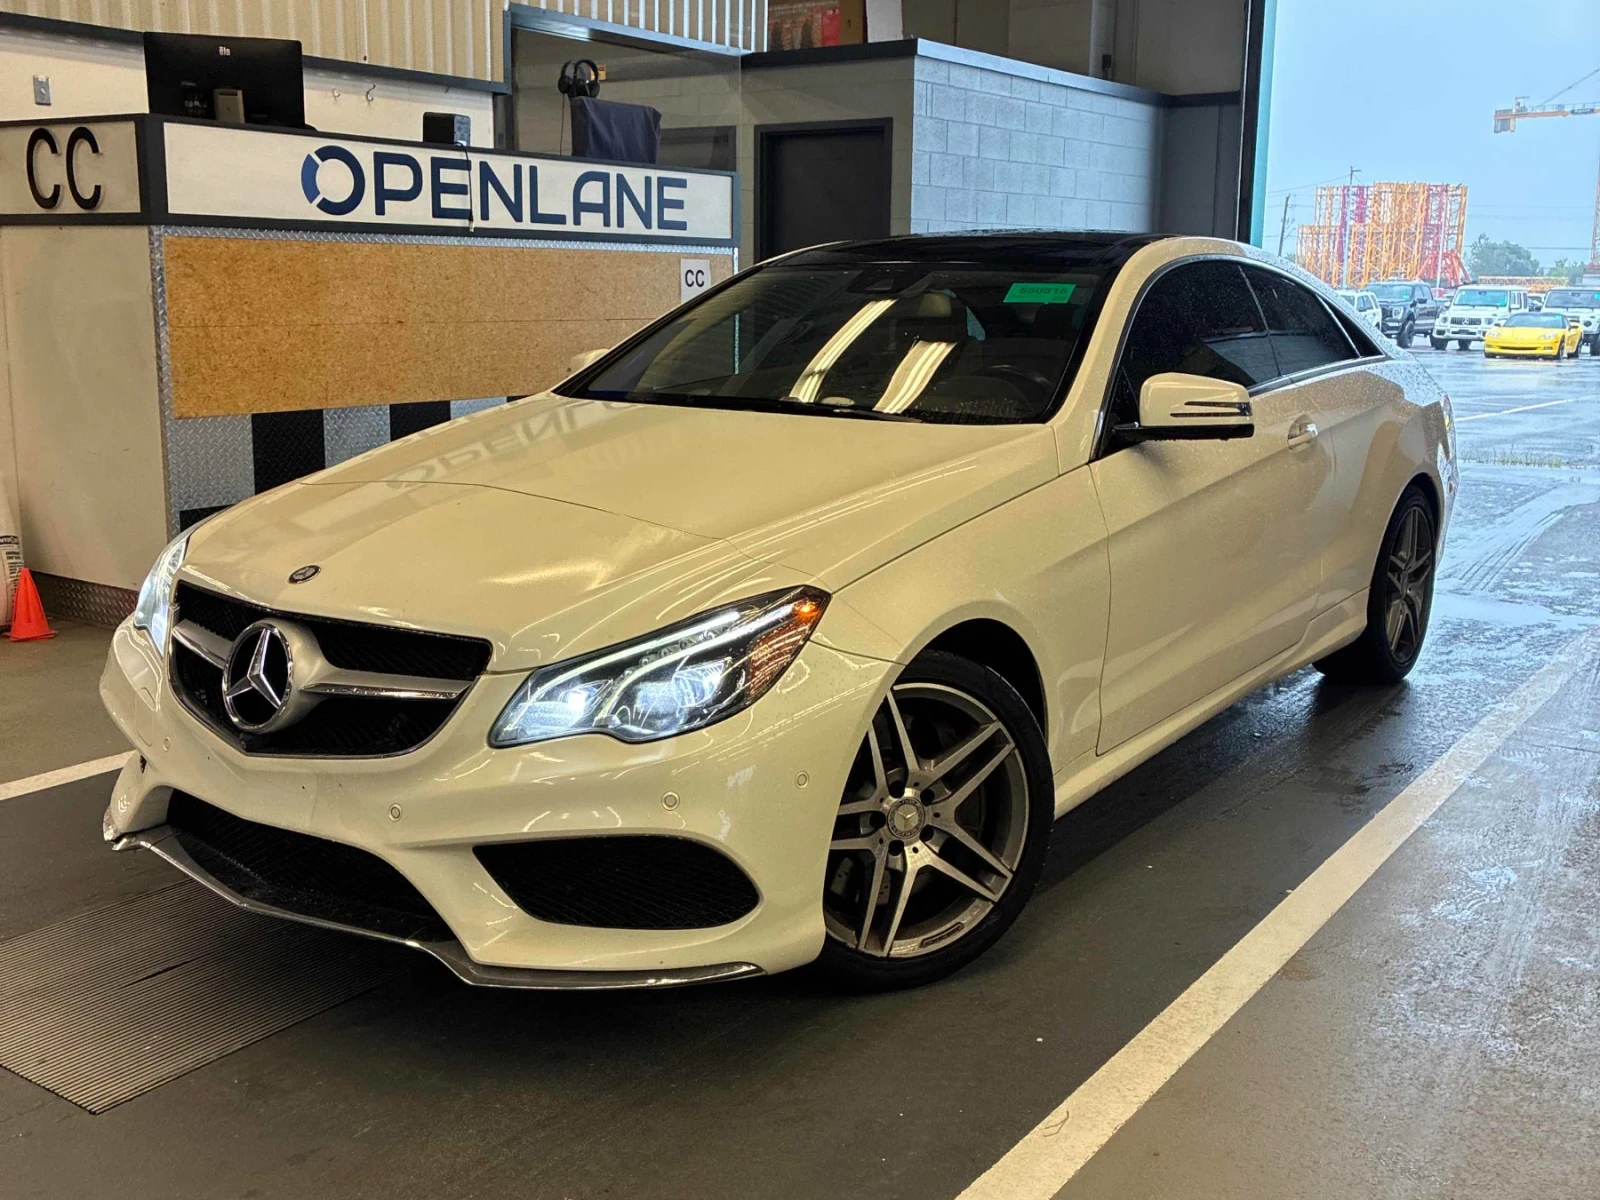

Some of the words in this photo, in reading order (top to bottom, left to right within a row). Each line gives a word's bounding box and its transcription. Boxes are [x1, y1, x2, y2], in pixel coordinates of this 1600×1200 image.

[27, 126, 101, 210] CC
[301, 145, 688, 231] OPENLANE
[685, 269, 705, 287] CC
